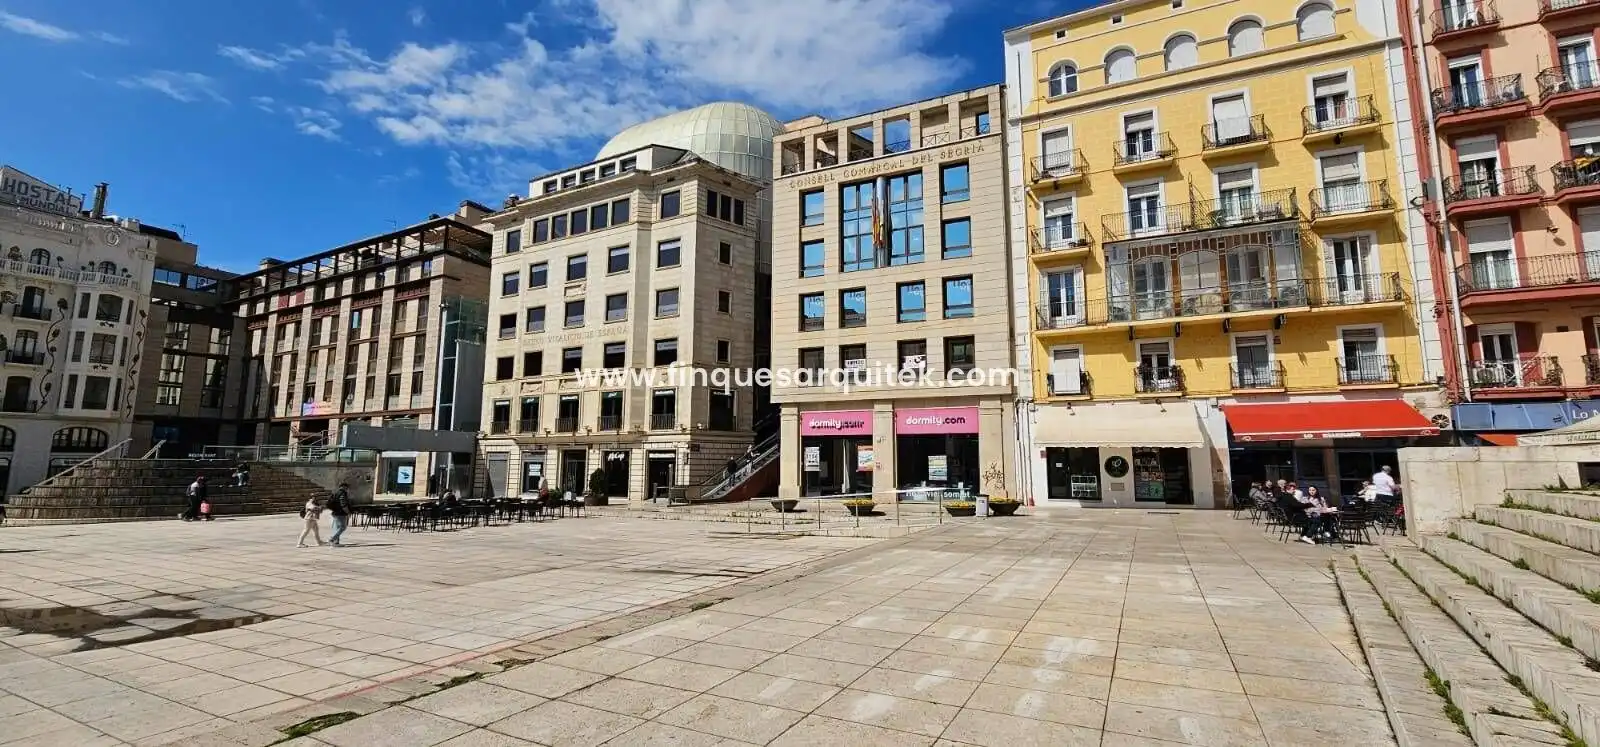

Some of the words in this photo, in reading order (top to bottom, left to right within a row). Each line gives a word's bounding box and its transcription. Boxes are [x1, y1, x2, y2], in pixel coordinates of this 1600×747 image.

[790, 174, 836, 189] CONSELL
[843, 159, 905, 178] COMARCAL
[912, 153, 934, 164] DEL
[940, 140, 985, 159] SEGRIÀ
[3, 177, 78, 208] HOSTAL
[19, 196, 75, 216] MUNDIAL
[905, 415, 966, 426] dormity.com
[1573, 409, 1589, 419] Lo
